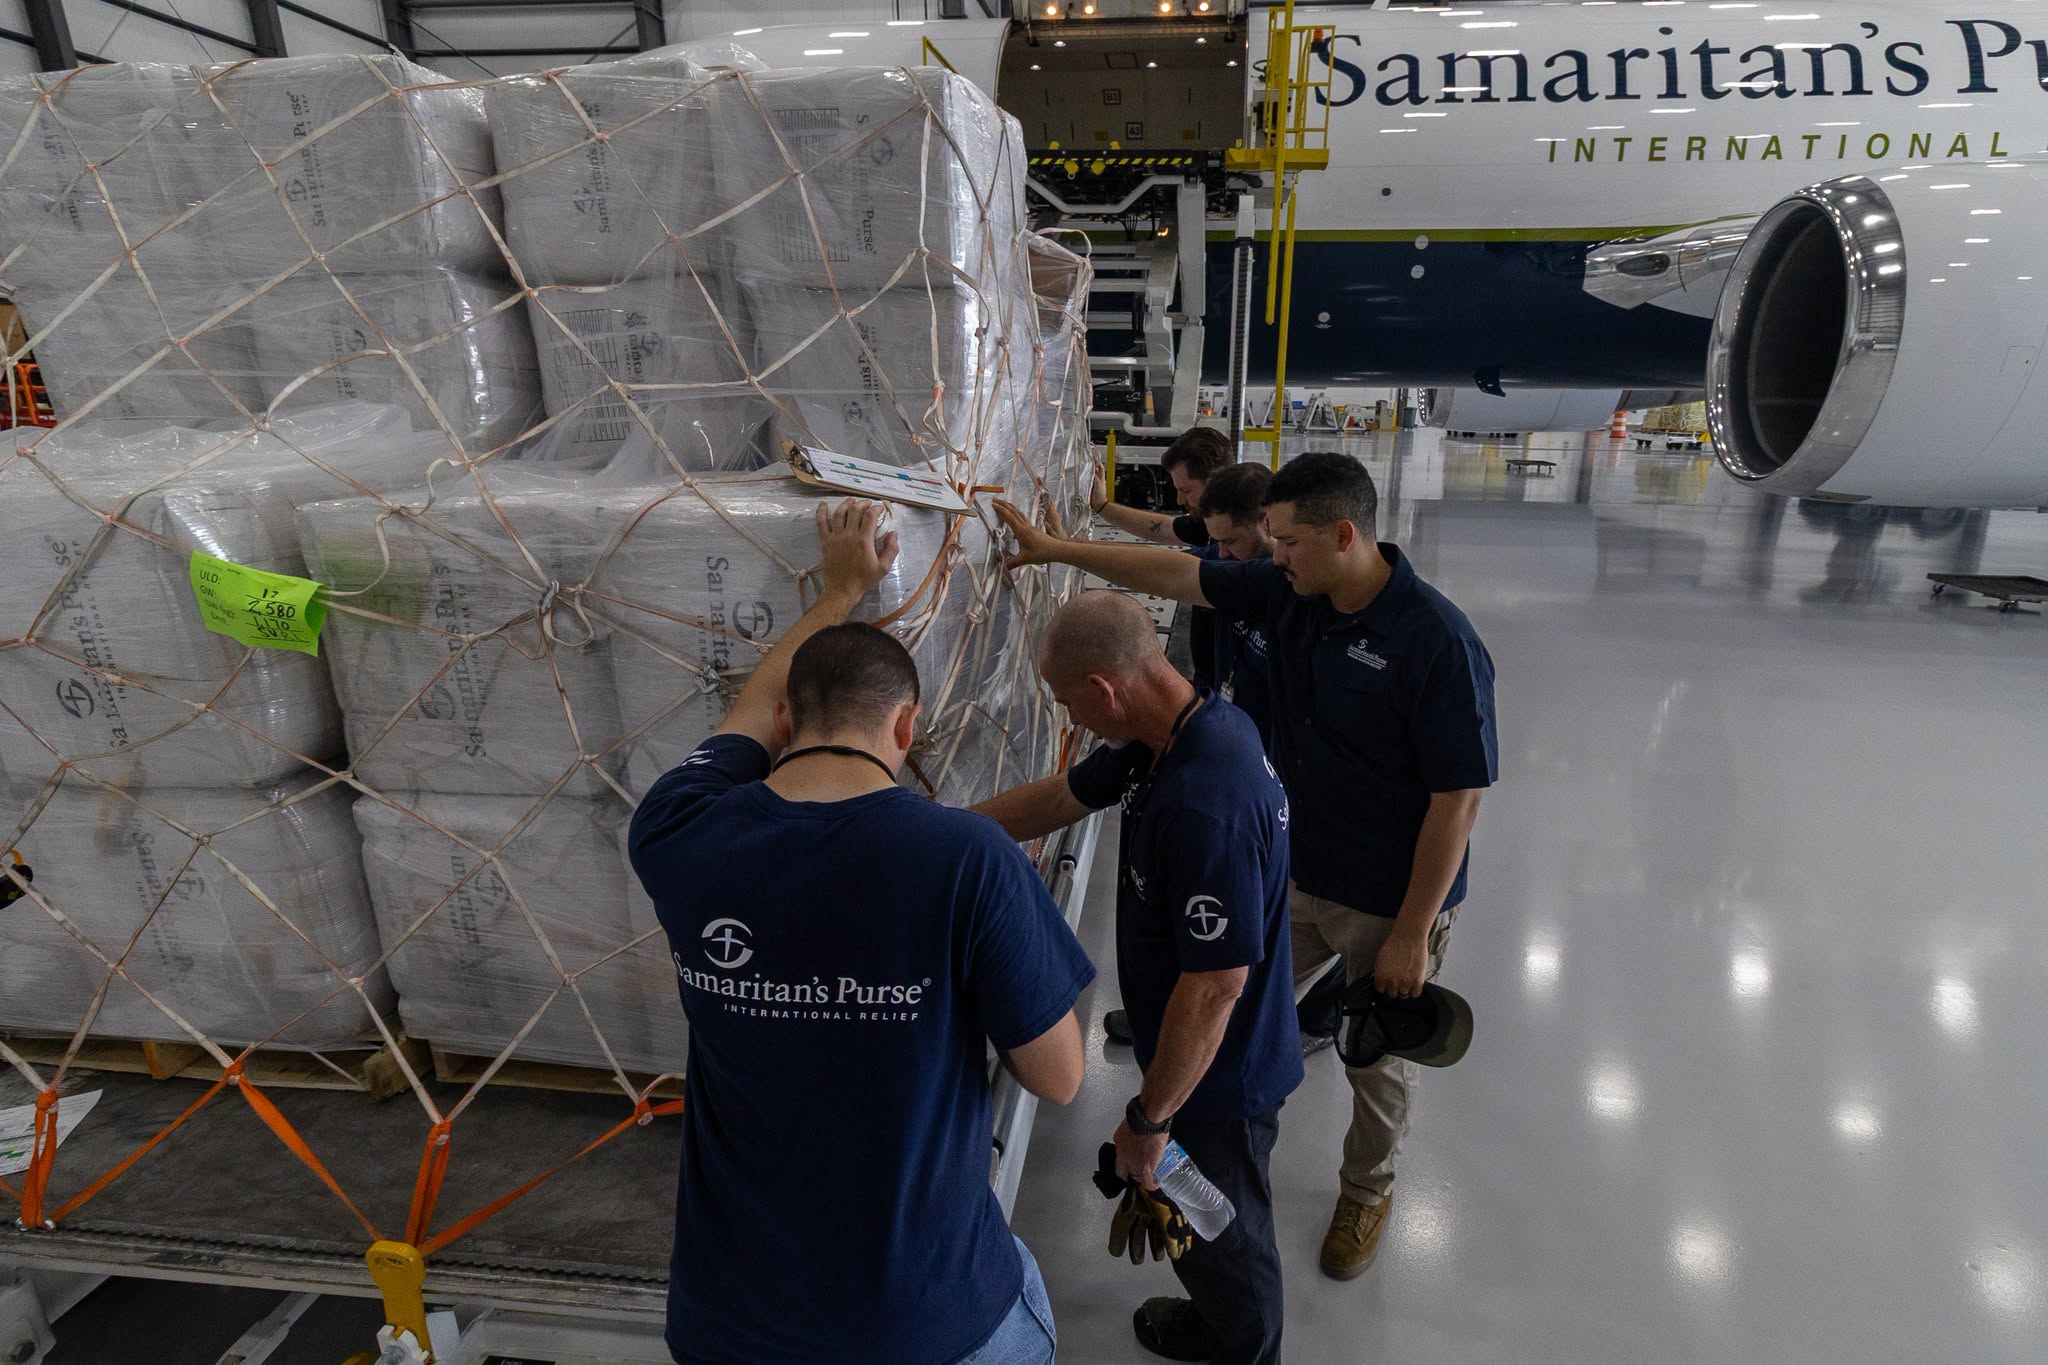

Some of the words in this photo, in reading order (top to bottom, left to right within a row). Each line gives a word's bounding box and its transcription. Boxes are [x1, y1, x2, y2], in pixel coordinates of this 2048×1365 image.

[1315, 22, 1930, 107] Samaritan's
[1548, 132, 2009, 163] INTERNATIONAL
[199, 569, 222, 585] ULD:
[674, 951, 829, 1004] Samaritan's
[724, 1003, 852, 1020] INTERNATIONAL
[859, 1011, 919, 1021] RELIEF
